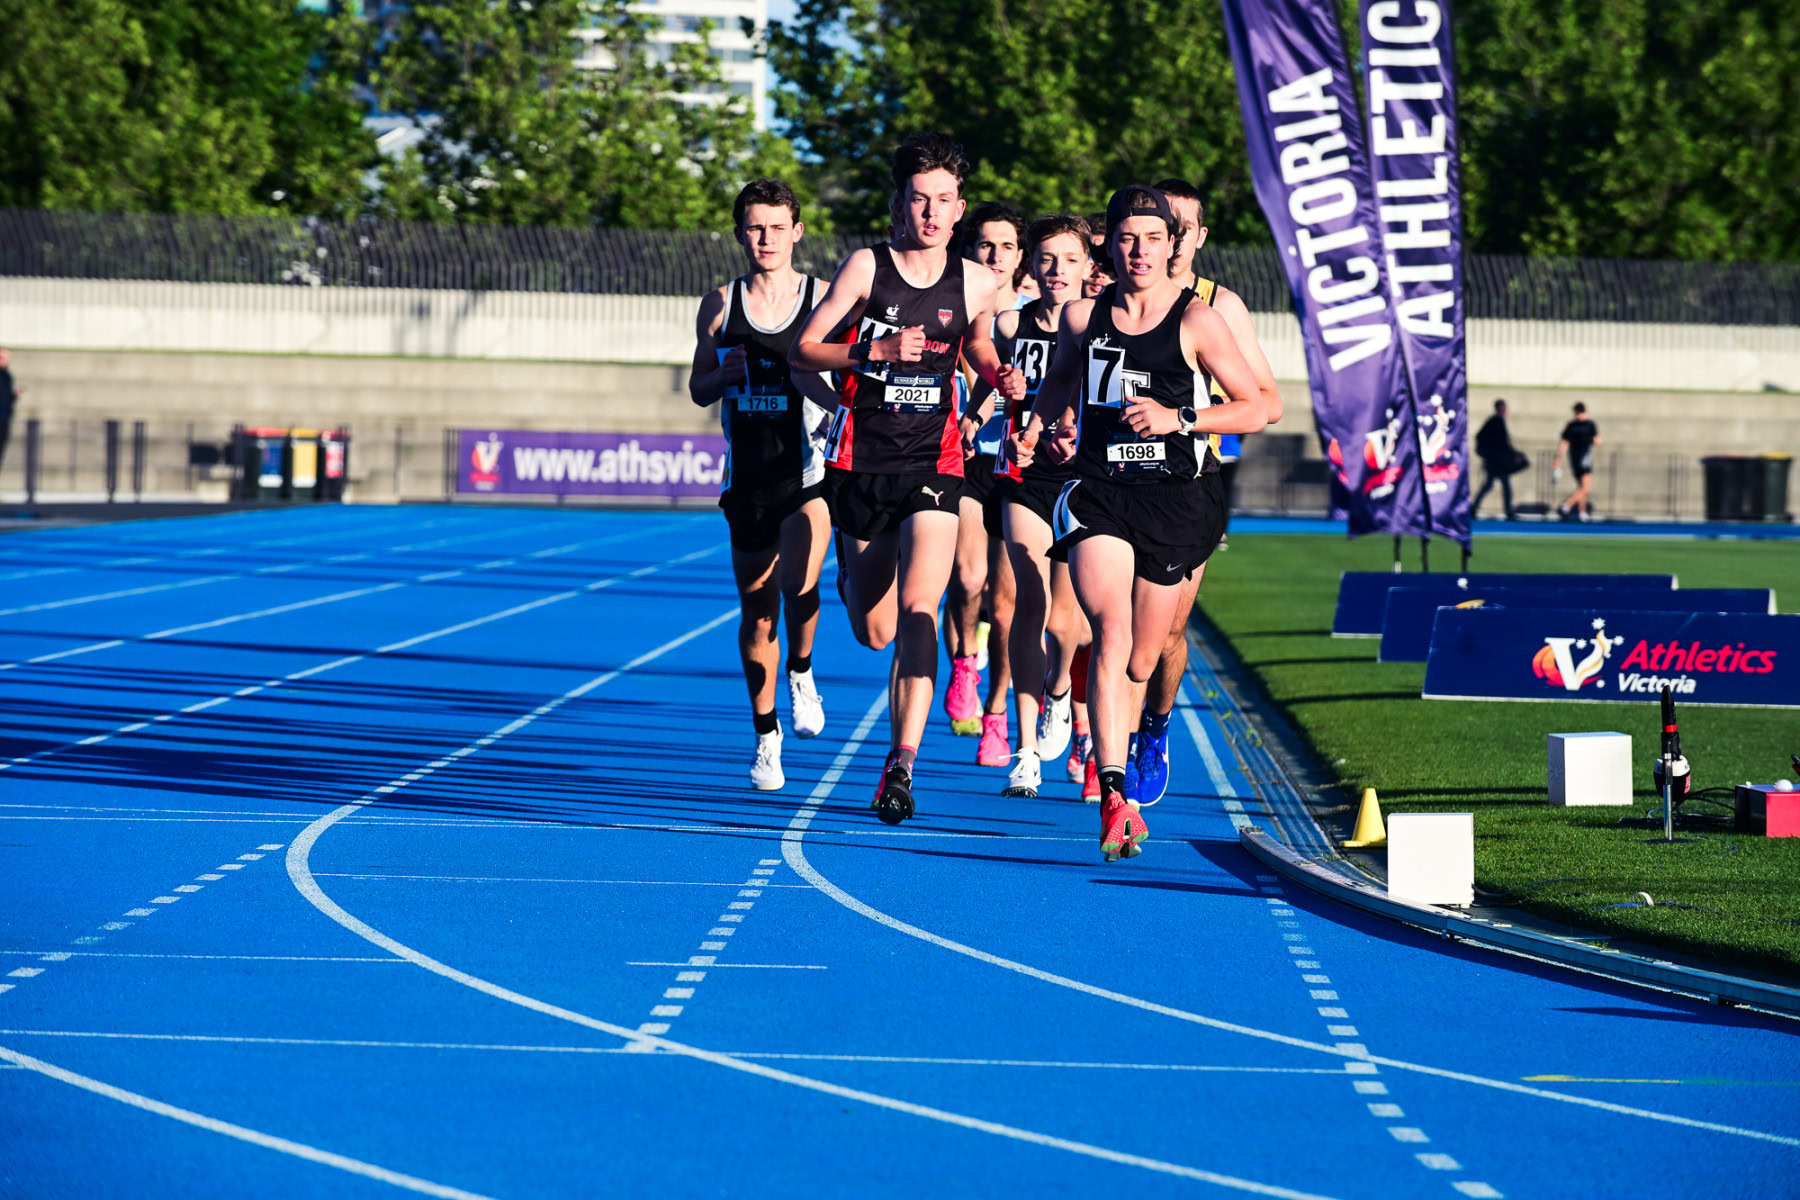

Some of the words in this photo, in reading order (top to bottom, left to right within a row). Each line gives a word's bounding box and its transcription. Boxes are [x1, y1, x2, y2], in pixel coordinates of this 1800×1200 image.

[1267, 66, 1393, 372] VICTORIA
[1016, 341, 1044, 391] 13
[1092, 347, 1122, 404] 7
[747, 397, 779, 410] 1716
[894, 388, 930, 402] 2021
[512, 439, 726, 485] www.athsvic.
[1117, 444, 1156, 460] 1698
[1620, 639, 1777, 674] Athletics
[1618, 672, 1697, 694] Victoria
